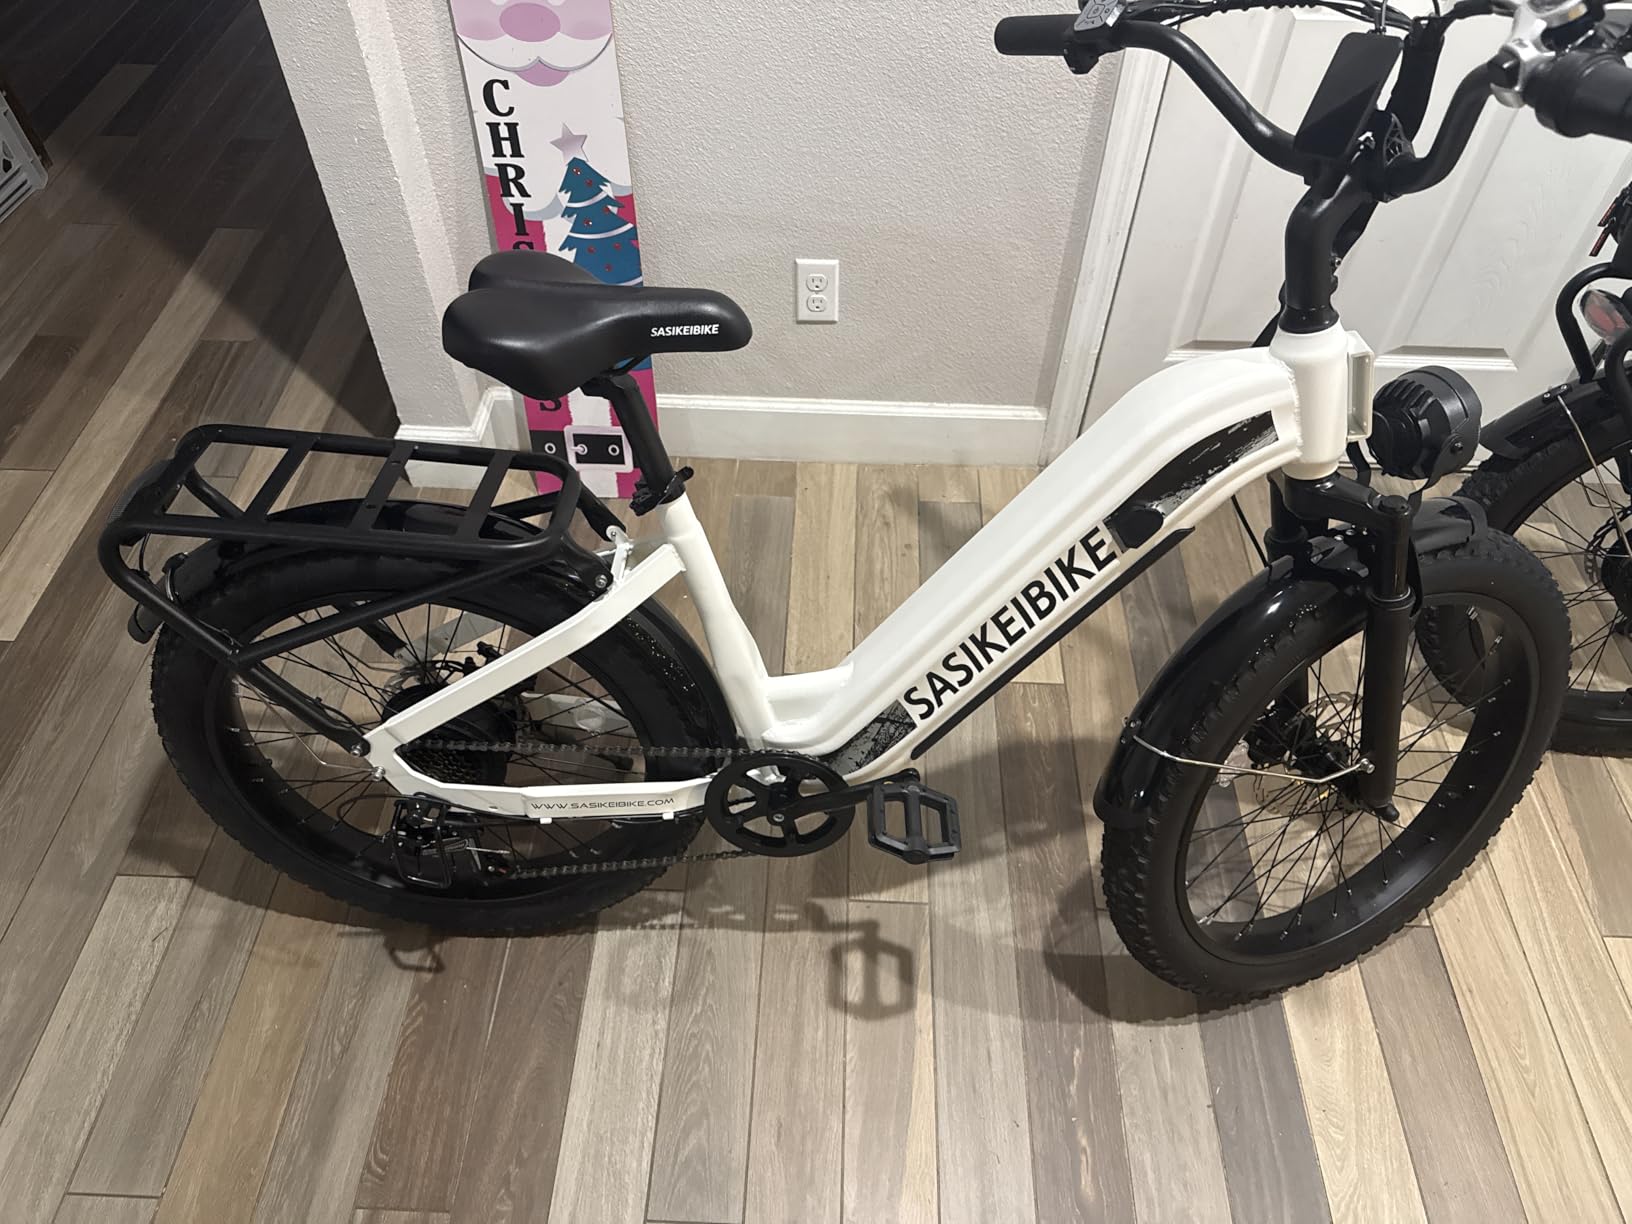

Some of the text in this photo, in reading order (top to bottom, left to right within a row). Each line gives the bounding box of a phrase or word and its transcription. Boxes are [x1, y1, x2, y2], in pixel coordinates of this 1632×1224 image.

[650, 323, 720, 337] SASIKEIBIKE
[903, 526, 1118, 720] SASIKEIBIKE
[530, 797, 675, 810] WWW.SASIKEIBIKE.COM
